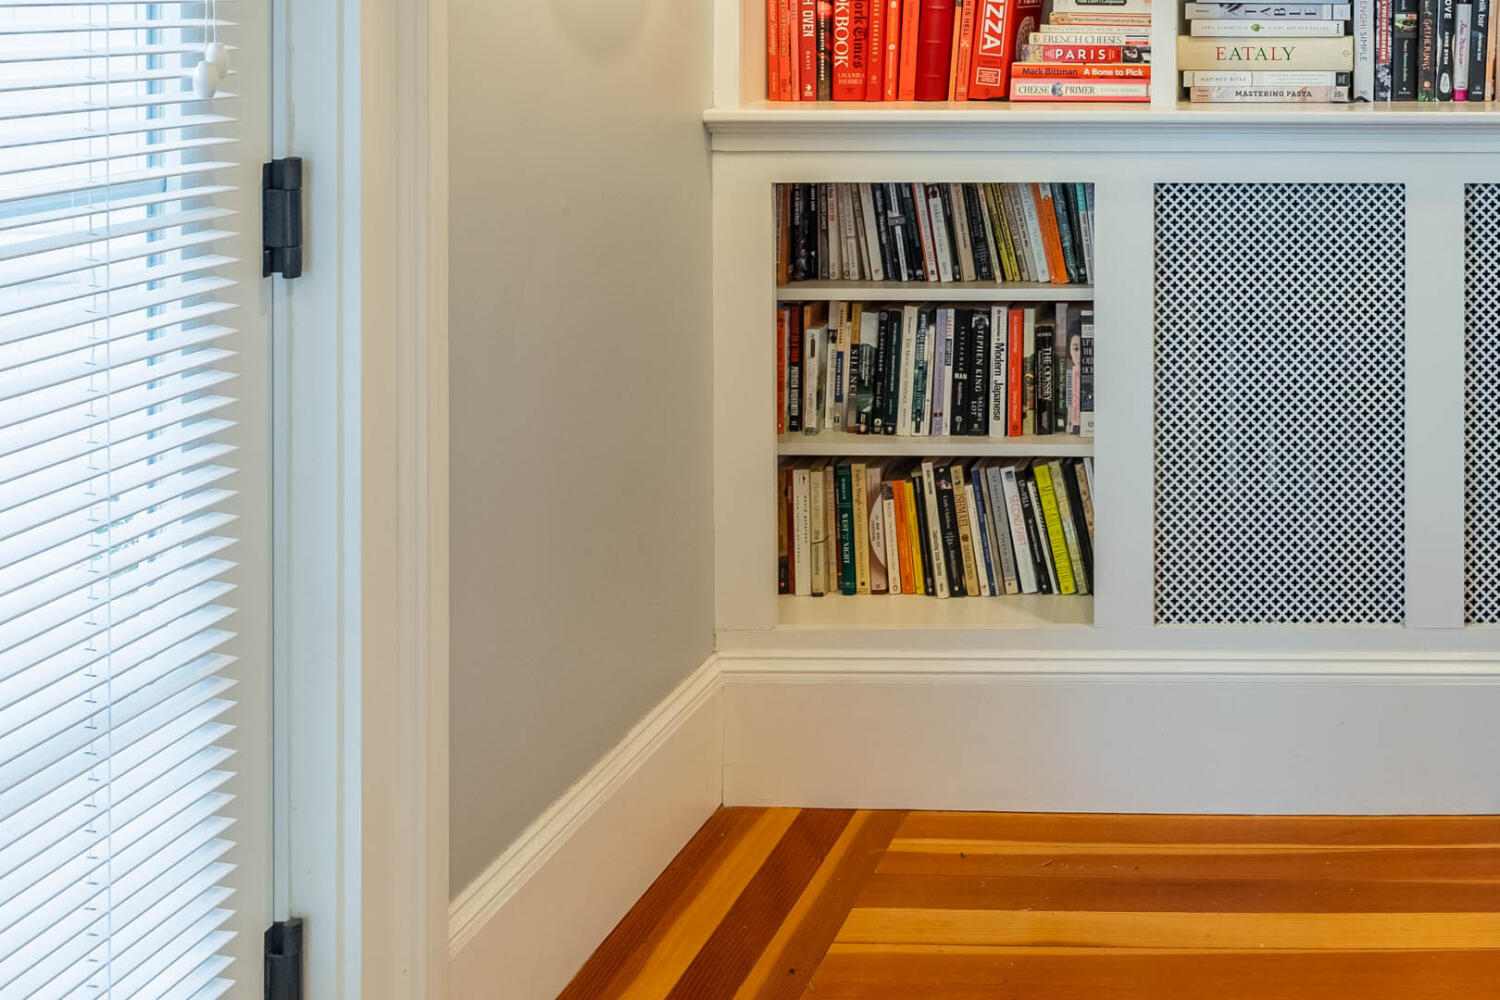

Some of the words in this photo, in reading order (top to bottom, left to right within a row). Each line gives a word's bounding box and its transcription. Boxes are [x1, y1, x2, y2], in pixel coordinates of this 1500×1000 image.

[803, 10, 815, 37] OVEN
[963, 19, 971, 37] HELL
[853, 27, 867, 69] Times
[1043, 34, 1082, 44] FRENCH
[1085, 34, 1123, 44] CHEESES
[1422, 19, 1432, 70] GATHERINGS
[1055, 48, 1106, 59] PARIS
[1216, 46, 1296, 61] EATALY
[1022, 68, 1044, 76] Mark
[1045, 68, 1078, 76] Bittman
[1091, 68, 1113, 76] Bone
[1126, 68, 1143, 76] Pick
[1018, 85, 1049, 94] CHEESE
[1064, 85, 1095, 94] PRIMER
[976, 325, 984, 365] STEPHEN
[1044, 348, 1052, 363] THE
[994, 343, 1005, 376] Modern
[849, 349, 857, 399] SILENCE
[1043, 366, 1052, 400] ODYSSEY
[992, 380, 1003, 421] Japanese
